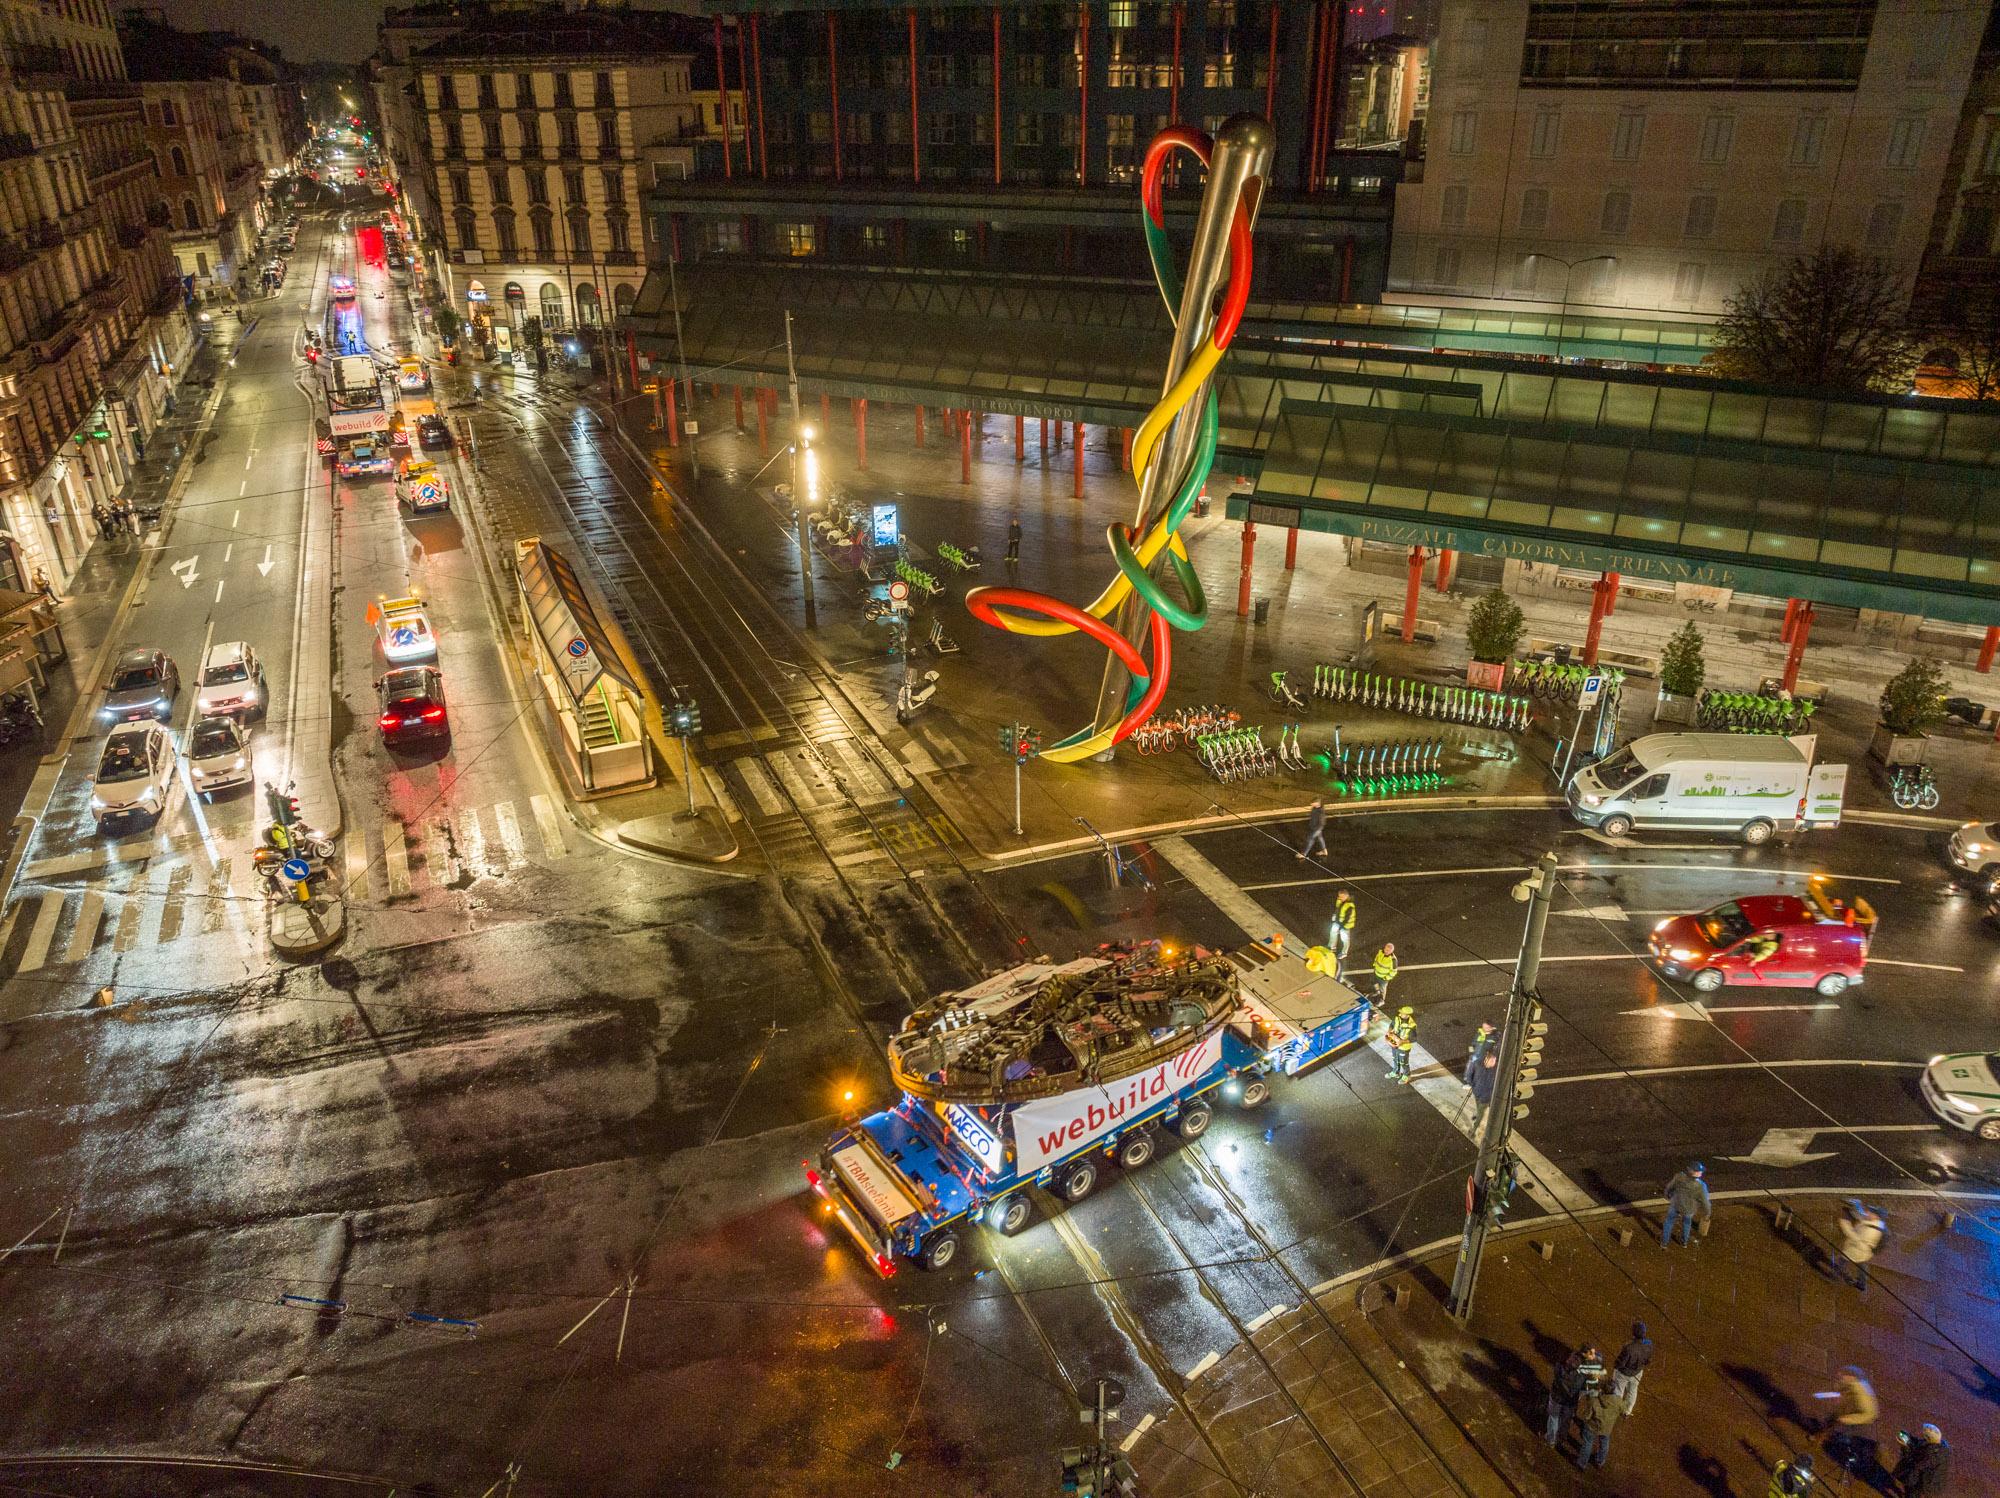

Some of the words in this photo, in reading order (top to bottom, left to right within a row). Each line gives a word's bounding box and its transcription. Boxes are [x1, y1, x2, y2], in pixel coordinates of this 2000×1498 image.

[335, 420, 371, 431] webuild
[1362, 521, 1457, 546] PIAZZALE
[1483, 537, 1585, 564] CADORNA
[1609, 554, 1736, 584] TRIENNALE
[1588, 680, 1597, 690] P
[1038, 1065, 1164, 1155] webuild
